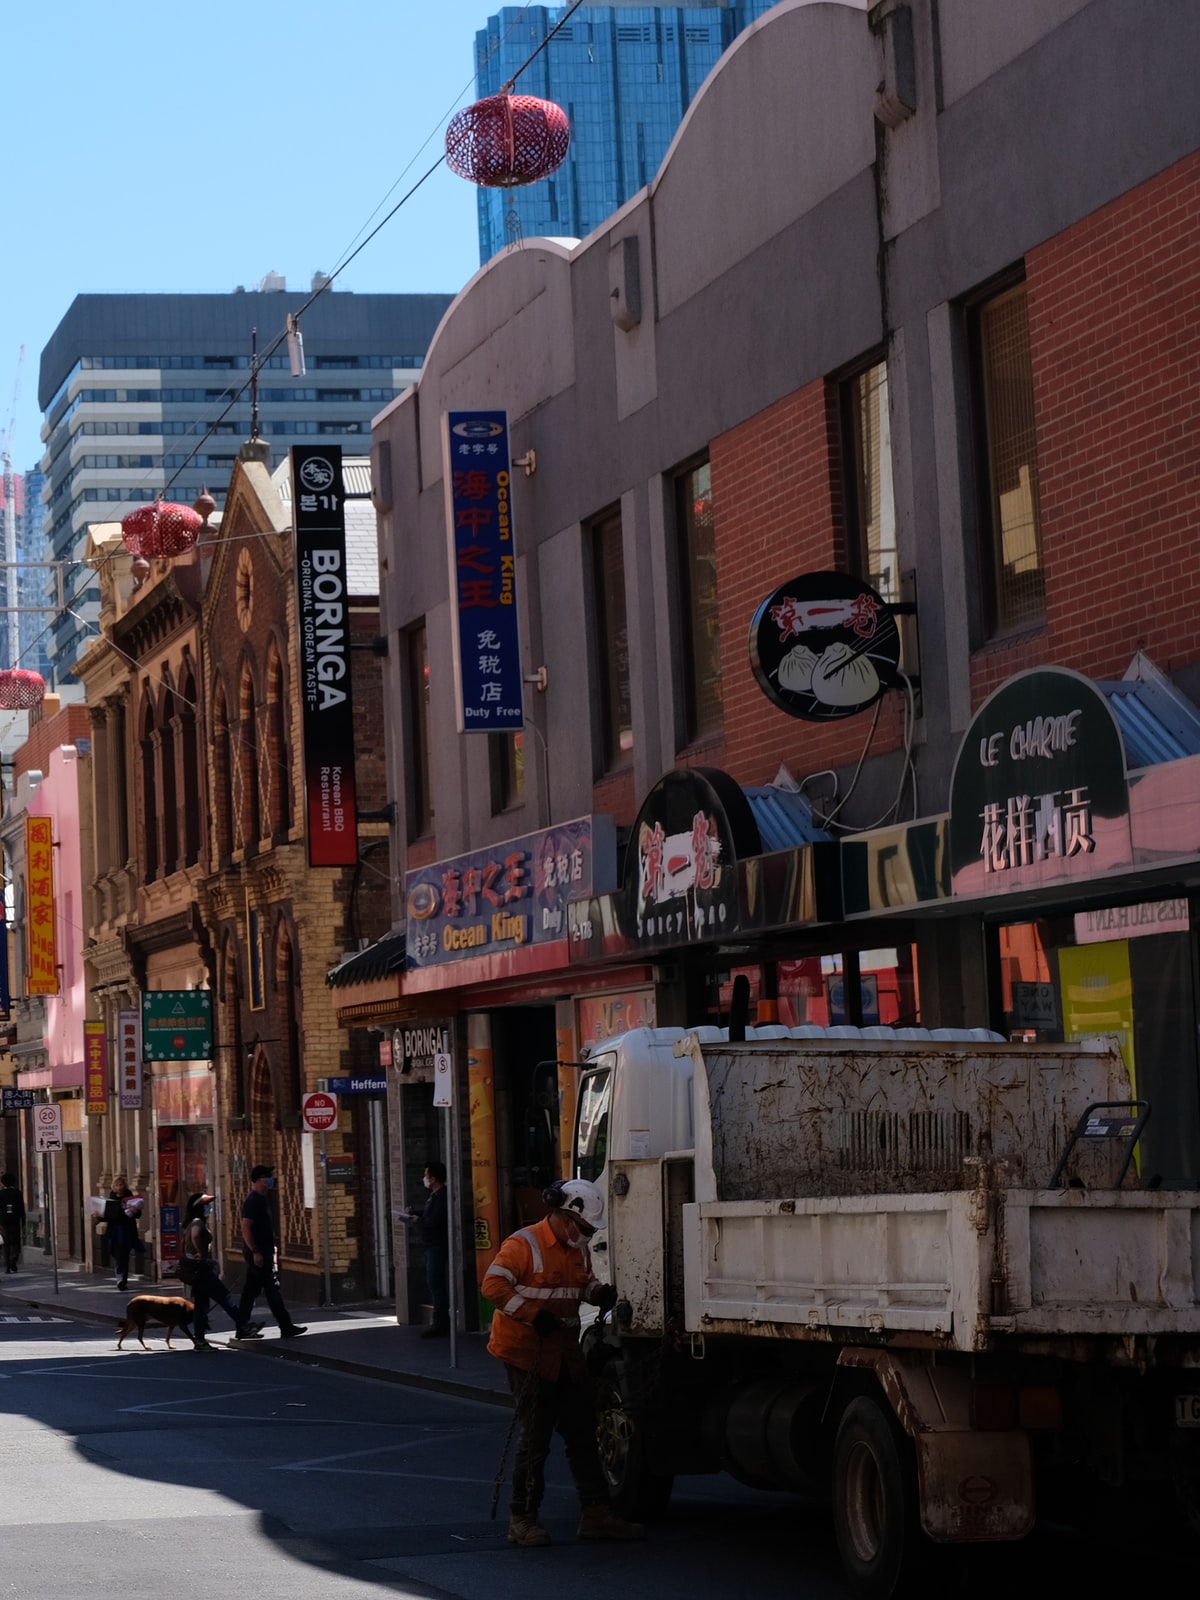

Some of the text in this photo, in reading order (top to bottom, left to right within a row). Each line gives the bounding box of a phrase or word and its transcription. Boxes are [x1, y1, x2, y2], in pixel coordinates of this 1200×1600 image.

[452, 469, 499, 608] 海中之王
[496, 470, 514, 605] Ocean King
[304, 616, 315, 663] KOREAN
[312, 549, 347, 711] BORNGA
[477, 629, 502, 702] 免税店
[465, 706, 520, 718] Duty Free
[980, 732, 1004, 767] LE
[320, 766, 331, 831] Restaurant
[332, 766, 345, 833] Korean BBQ
[443, 912, 525, 950] Ocean King
[543, 908, 562, 933] Duty
[32, 930, 53, 956] LING
[405, 1027, 444, 1058] BORNGA
[42, 1111, 53, 1120] 20
[88, 1103, 105, 1112] 202
[309, 1116, 331, 1124] ENTRY
